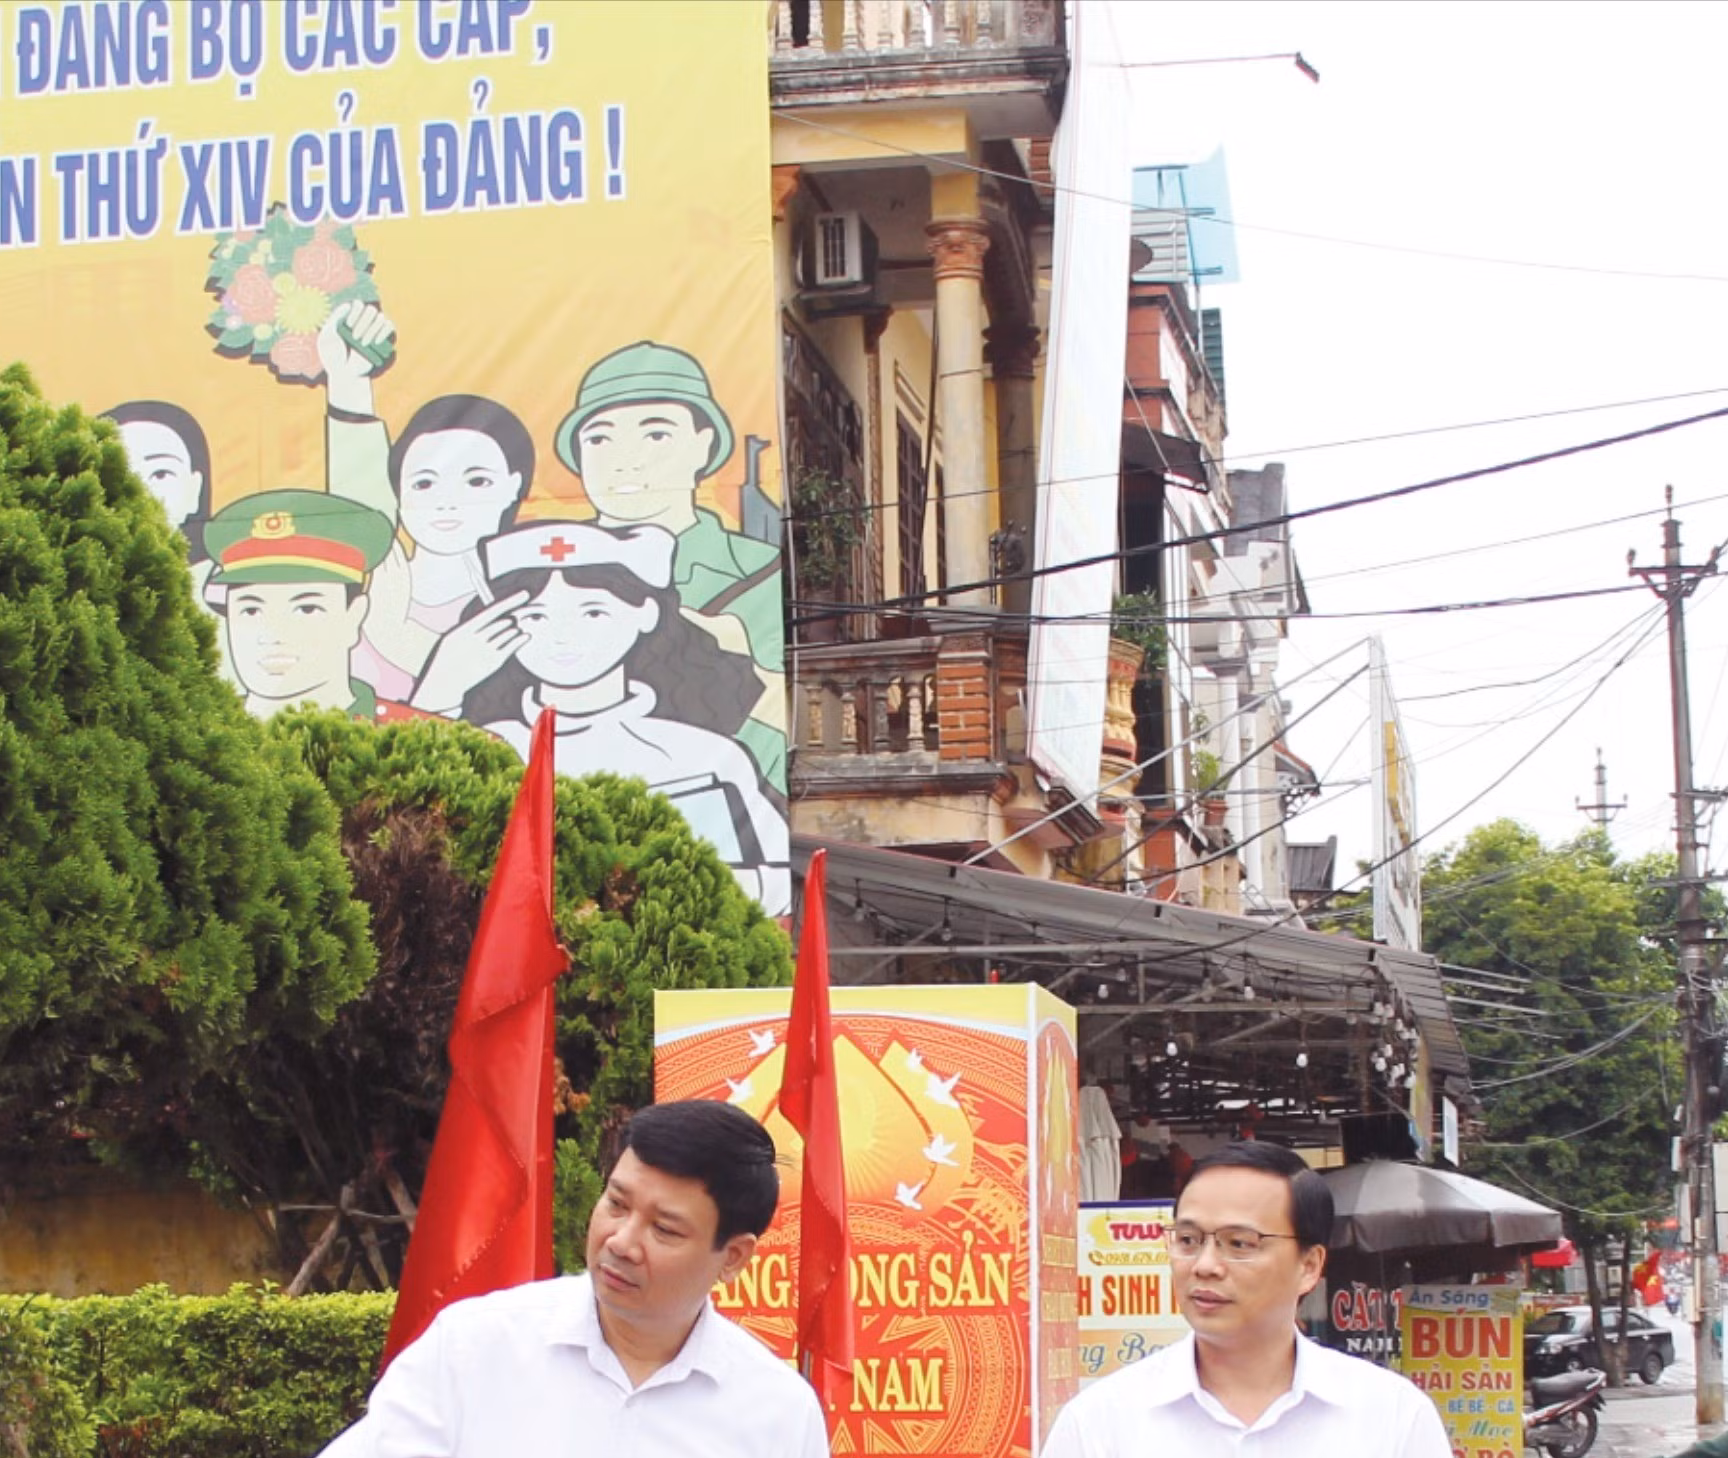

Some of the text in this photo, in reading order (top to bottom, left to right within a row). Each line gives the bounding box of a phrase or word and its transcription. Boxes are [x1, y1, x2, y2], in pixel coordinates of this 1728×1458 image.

[55, 122, 167, 240] THỨ
[179, 139, 270, 231] XIV
[290, 92, 404, 223] CỦA
[422, 80, 584, 211] ĐẢNG
[711, 1231, 1012, 1308] NG NG SẢN
[1102, 1275, 1160, 1316] SINH
[1411, 1307, 1511, 1359] BÚN
[850, 1358, 943, 1412] NAM
[1411, 1363, 1513, 1390] HẢI SẢN
